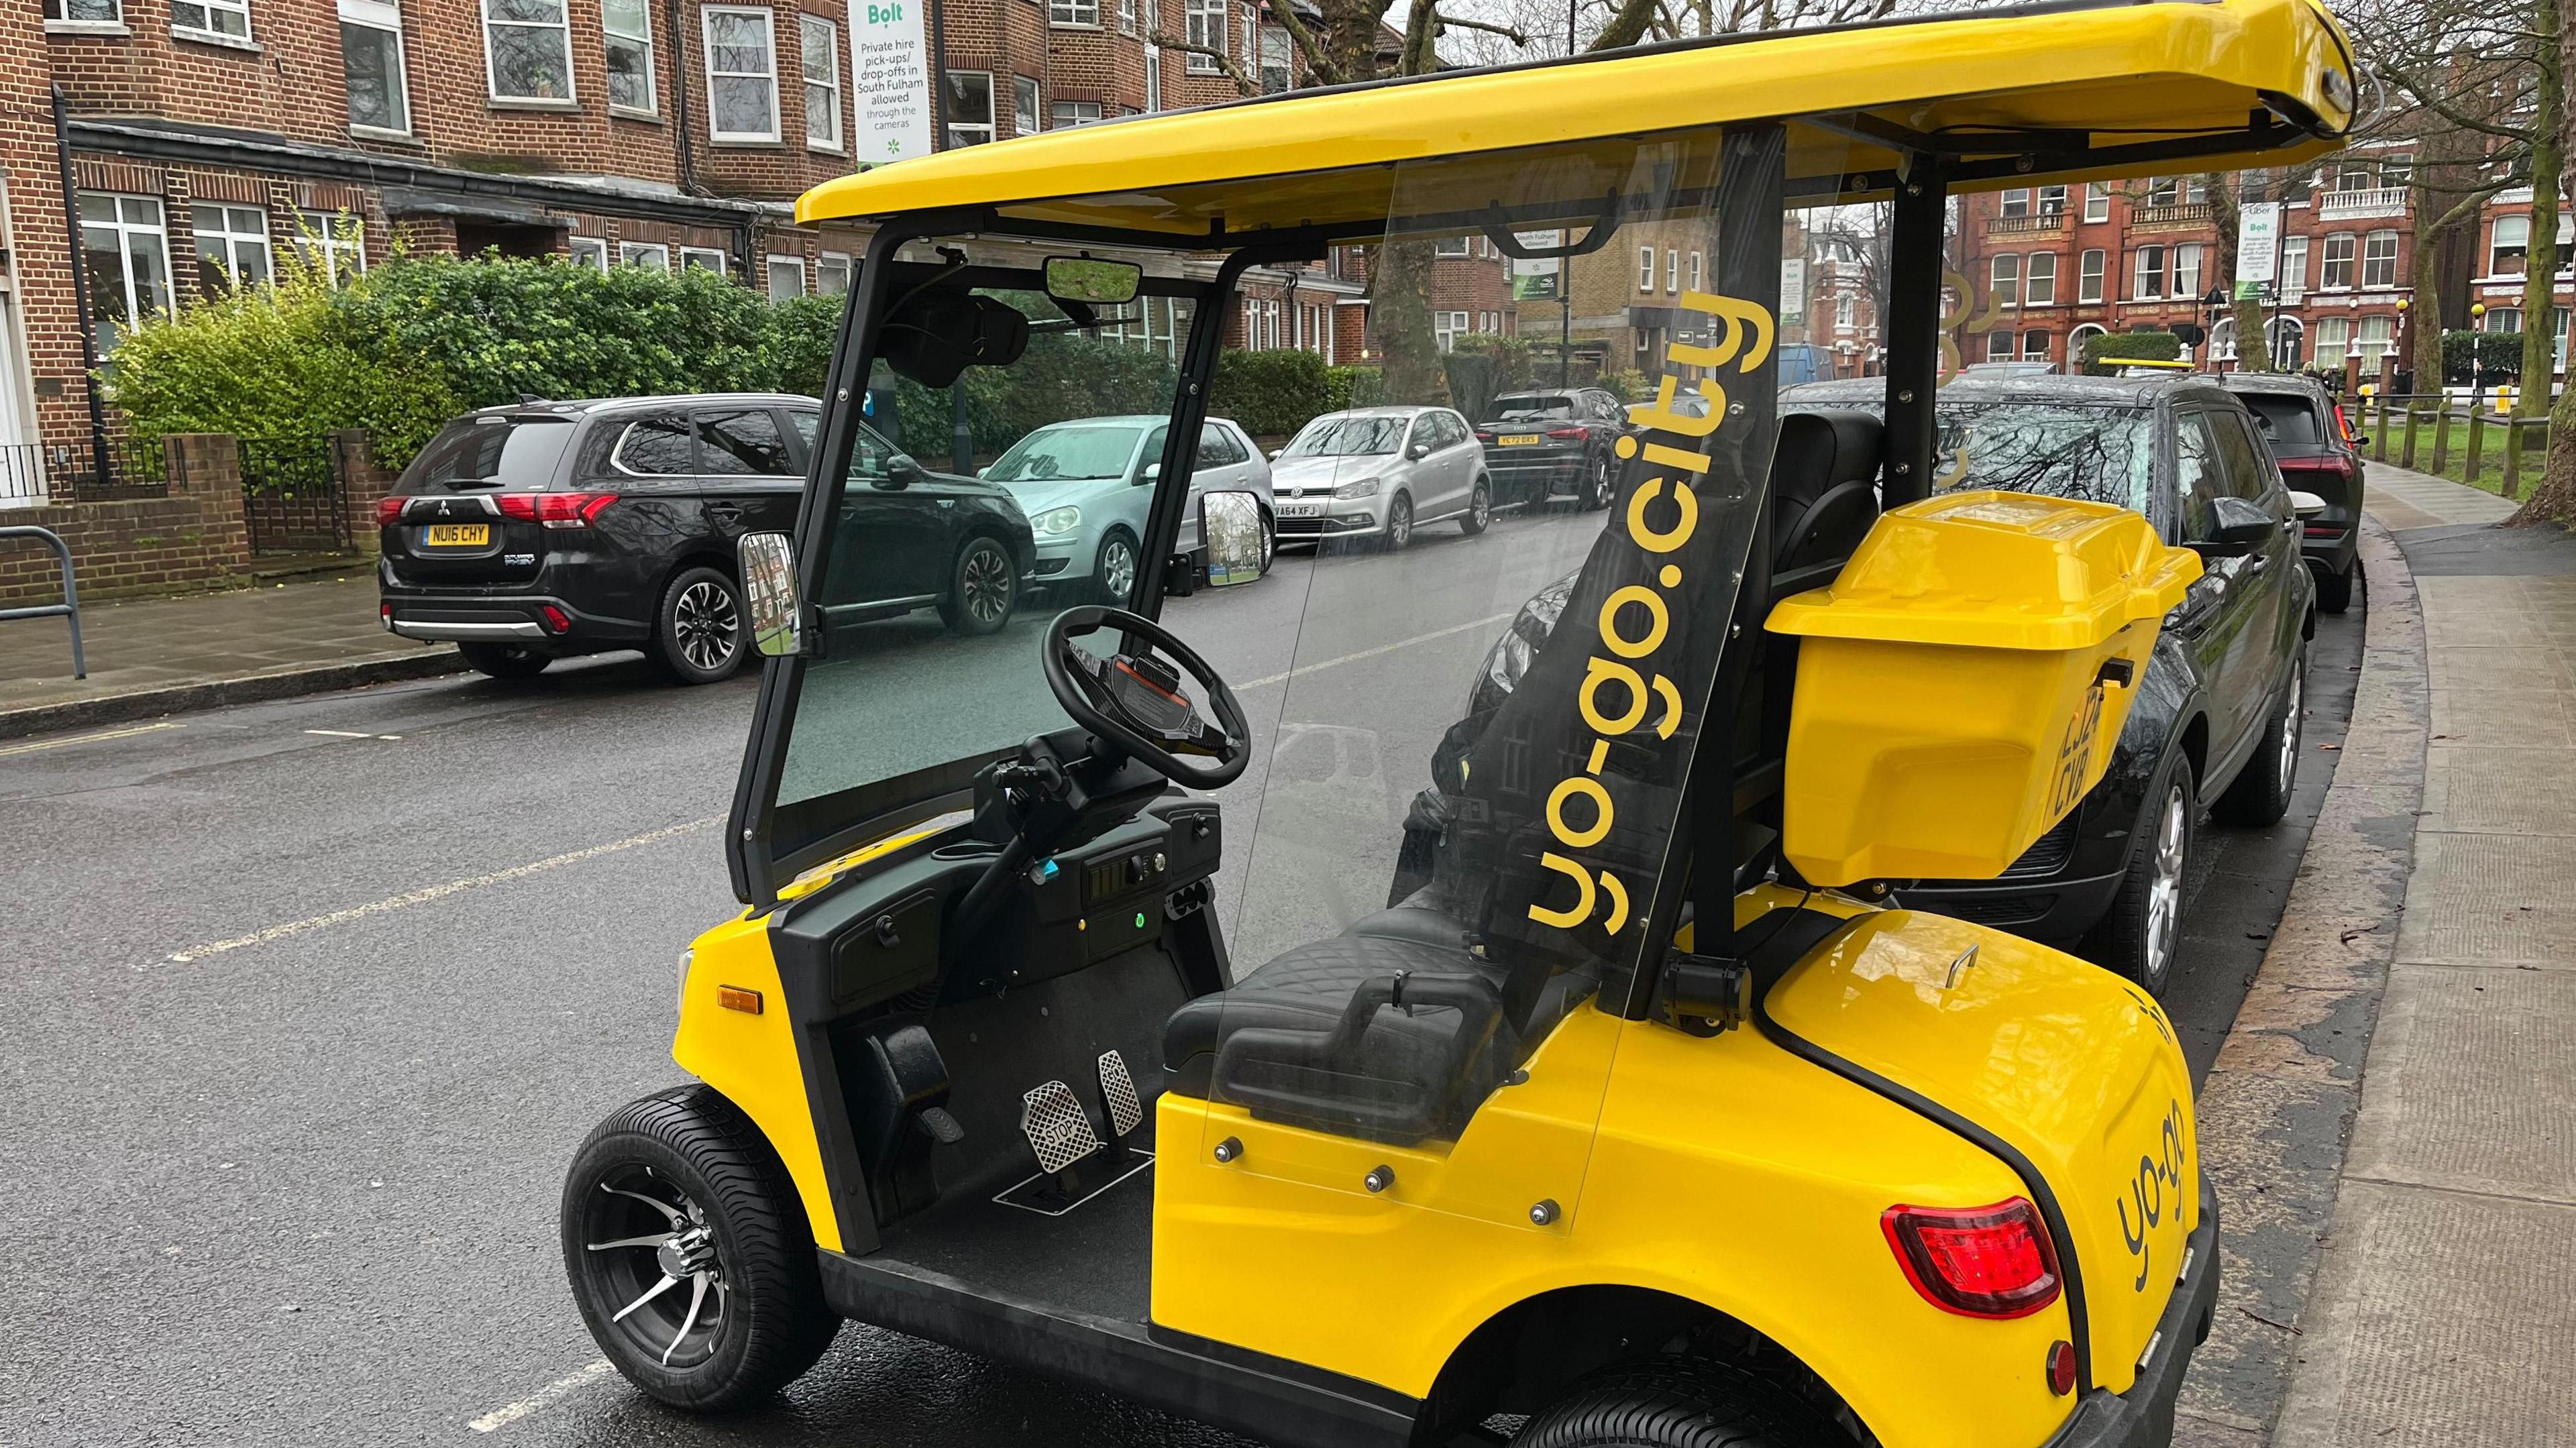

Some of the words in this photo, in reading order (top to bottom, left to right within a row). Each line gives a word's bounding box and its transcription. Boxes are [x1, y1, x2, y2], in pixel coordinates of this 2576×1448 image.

[868, 3, 903, 27] Bolt
[861, 42, 892, 54] Private
[896, 40, 914, 50] hire
[865, 52, 911, 68] pick-ups/
[861, 66, 906, 80] drop-offs
[909, 66, 918, 75] in
[858, 80, 885, 94] South
[888, 78, 923, 91] Fulham
[871, 93, 909, 105] allowed
[867, 106, 900, 119] through
[902, 104, 916, 116] the
[874, 120, 910, 130] cameras
[2249, 207, 2270, 215] Uber
[2250, 223, 2267, 232] Bolt
[1298, 506, 1316, 516] XFJ
[433, 526, 458, 542] NU16
[462, 525, 485, 541] CHY
[1528, 290, 1774, 936] yo-go.city
[2055, 747, 2089, 816] CVB
[1106, 1067, 1122, 1080] GO
[1046, 1120, 1073, 1144] STOP
[2117, 1099, 2185, 1293] yo-go
